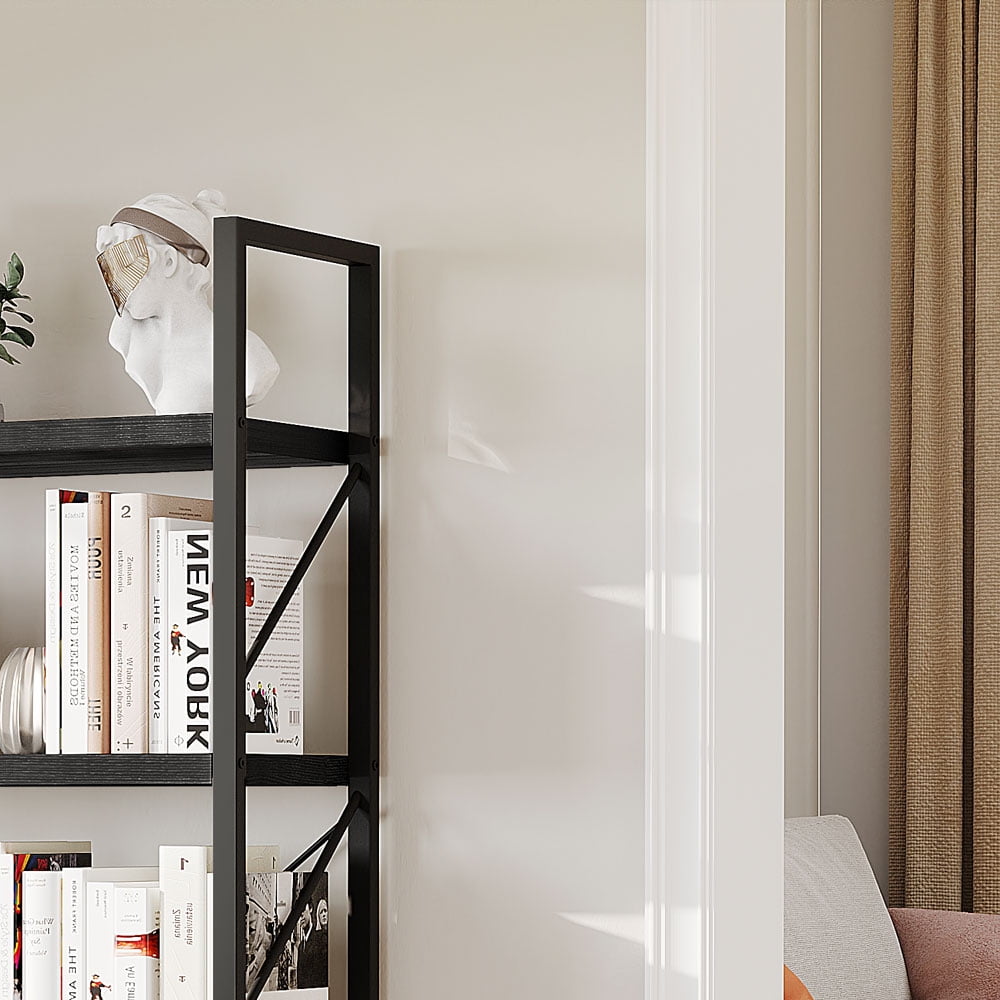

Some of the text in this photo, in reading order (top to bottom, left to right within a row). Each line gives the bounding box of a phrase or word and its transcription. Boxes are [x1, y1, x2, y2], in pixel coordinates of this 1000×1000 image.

[121, 505, 131, 519] 2
[126, 556, 134, 586] Zmiana
[116, 640, 124, 685] przestrzeni
[124, 657, 134, 708] W labiryncie
[116, 690, 125, 726] obrazów
